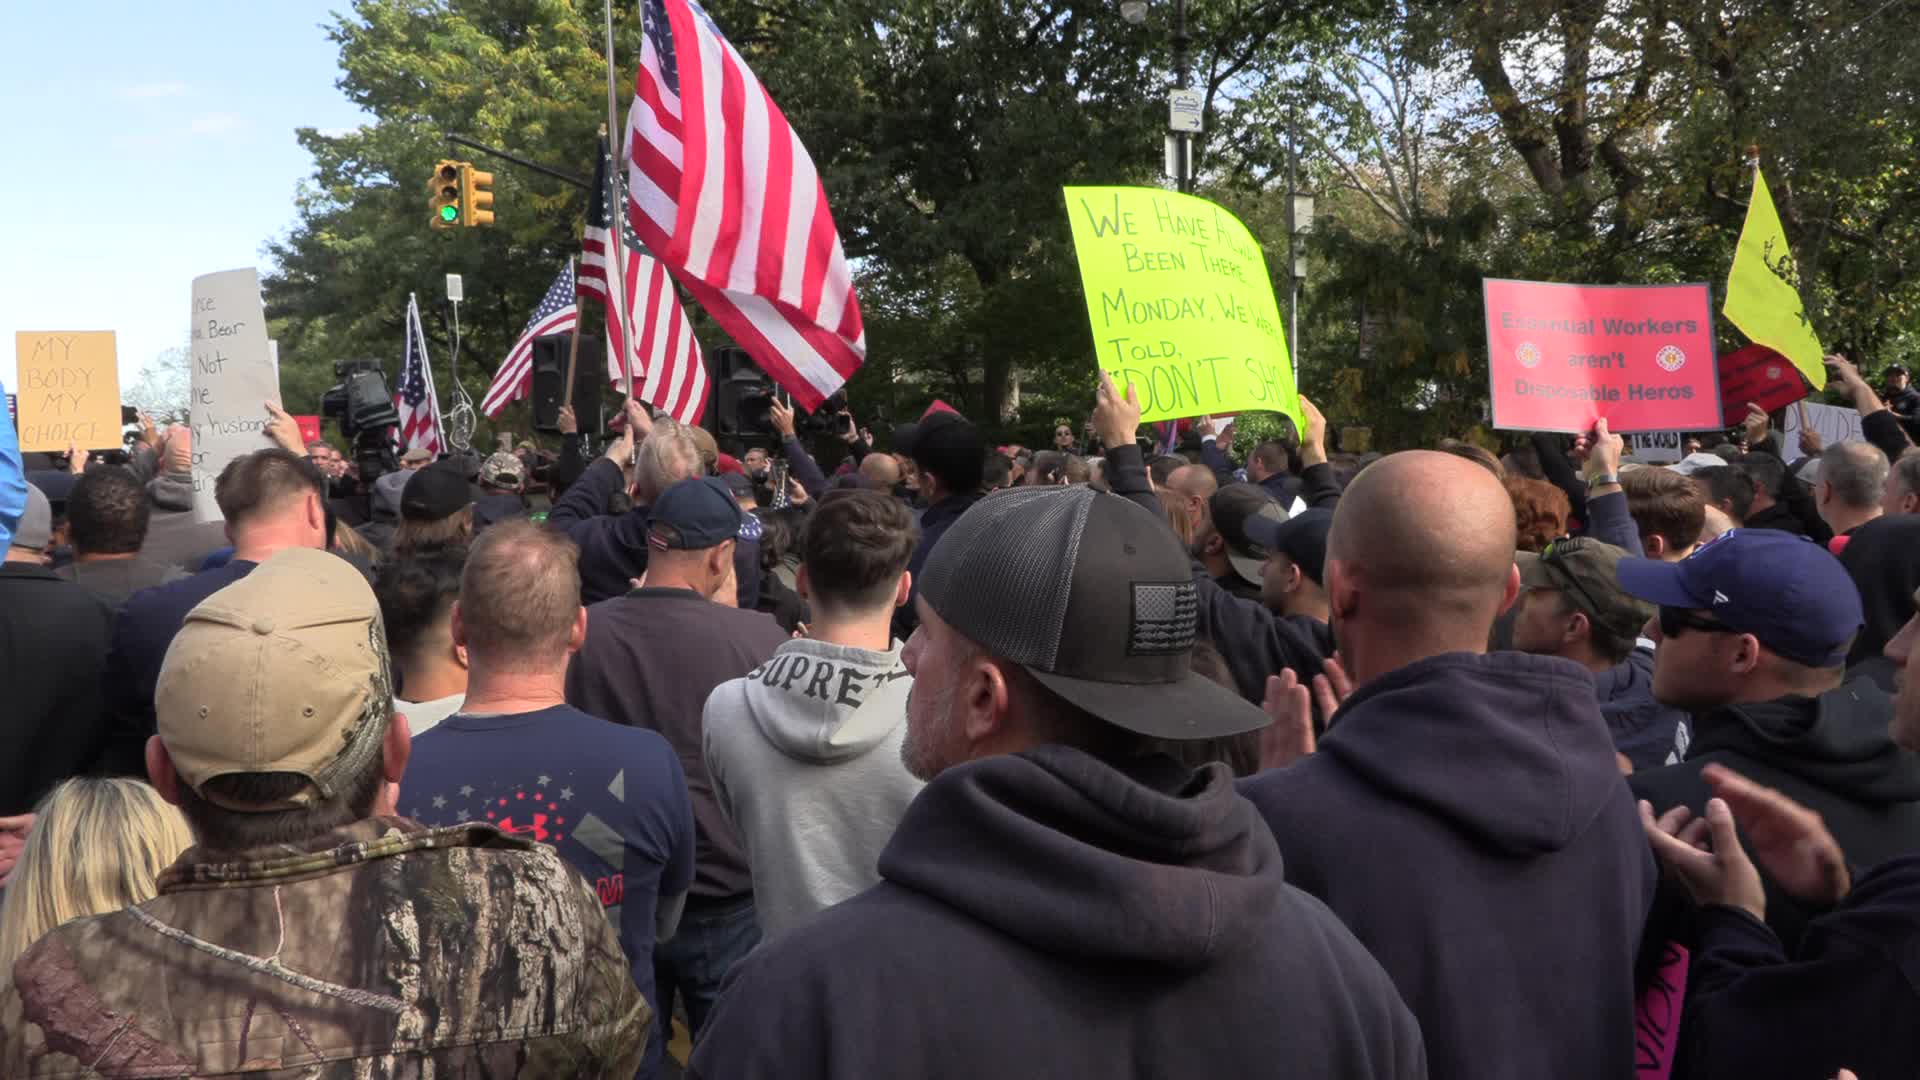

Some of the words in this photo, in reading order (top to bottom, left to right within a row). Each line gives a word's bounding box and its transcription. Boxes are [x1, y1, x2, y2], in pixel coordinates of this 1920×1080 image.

[1152, 196, 1210, 241] HAVE
[1121, 242, 1186, 273] BEEN
[1215, 292, 1249, 324] WE
[208, 319, 246, 339] Bear
[1602, 317, 1697, 336] Workers
[31, 335, 80, 361] MY
[1567, 351, 1627, 369] aren't
[198, 350, 229, 377] Not
[25, 367, 96, 390] BODY
[1514, 378, 1620, 402] Disposable
[1627, 383, 1695, 401] Heros
[40, 392, 87, 417] MY
